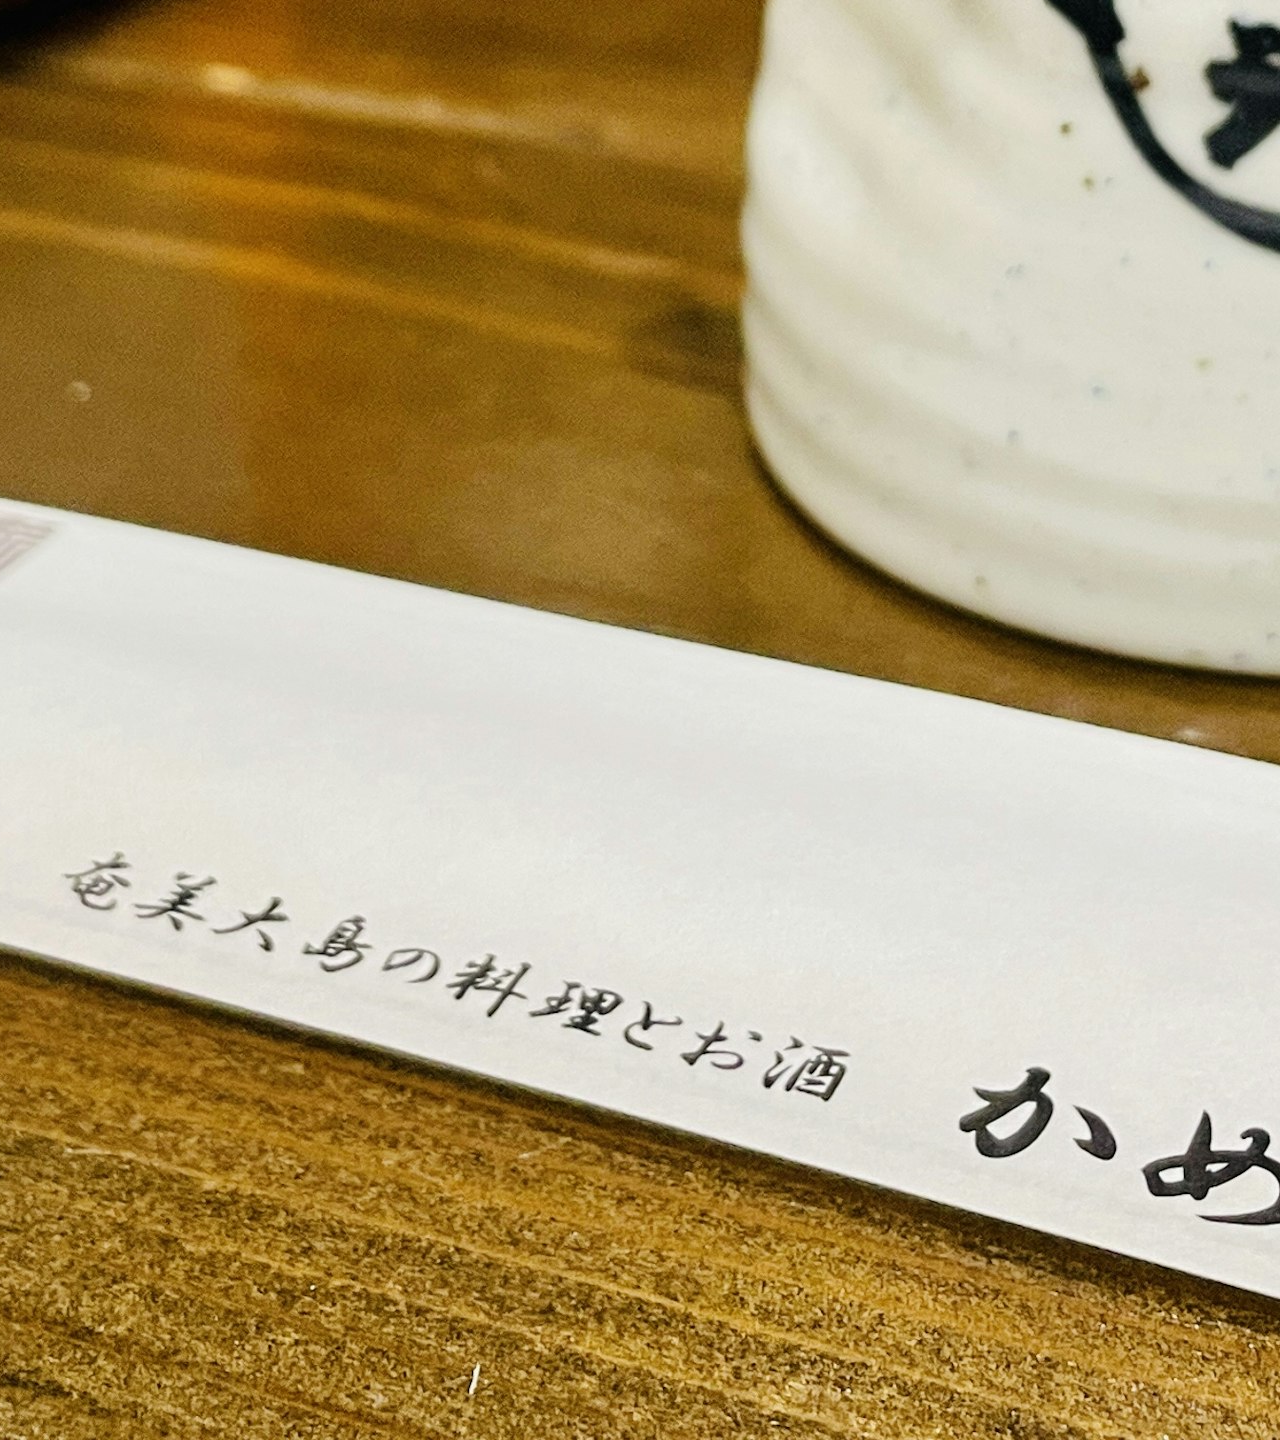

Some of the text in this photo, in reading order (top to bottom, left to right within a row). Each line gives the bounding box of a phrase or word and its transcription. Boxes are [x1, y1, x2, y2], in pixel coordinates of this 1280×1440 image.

[63, 850, 852, 1102] 奄美大島の料理とお酒
